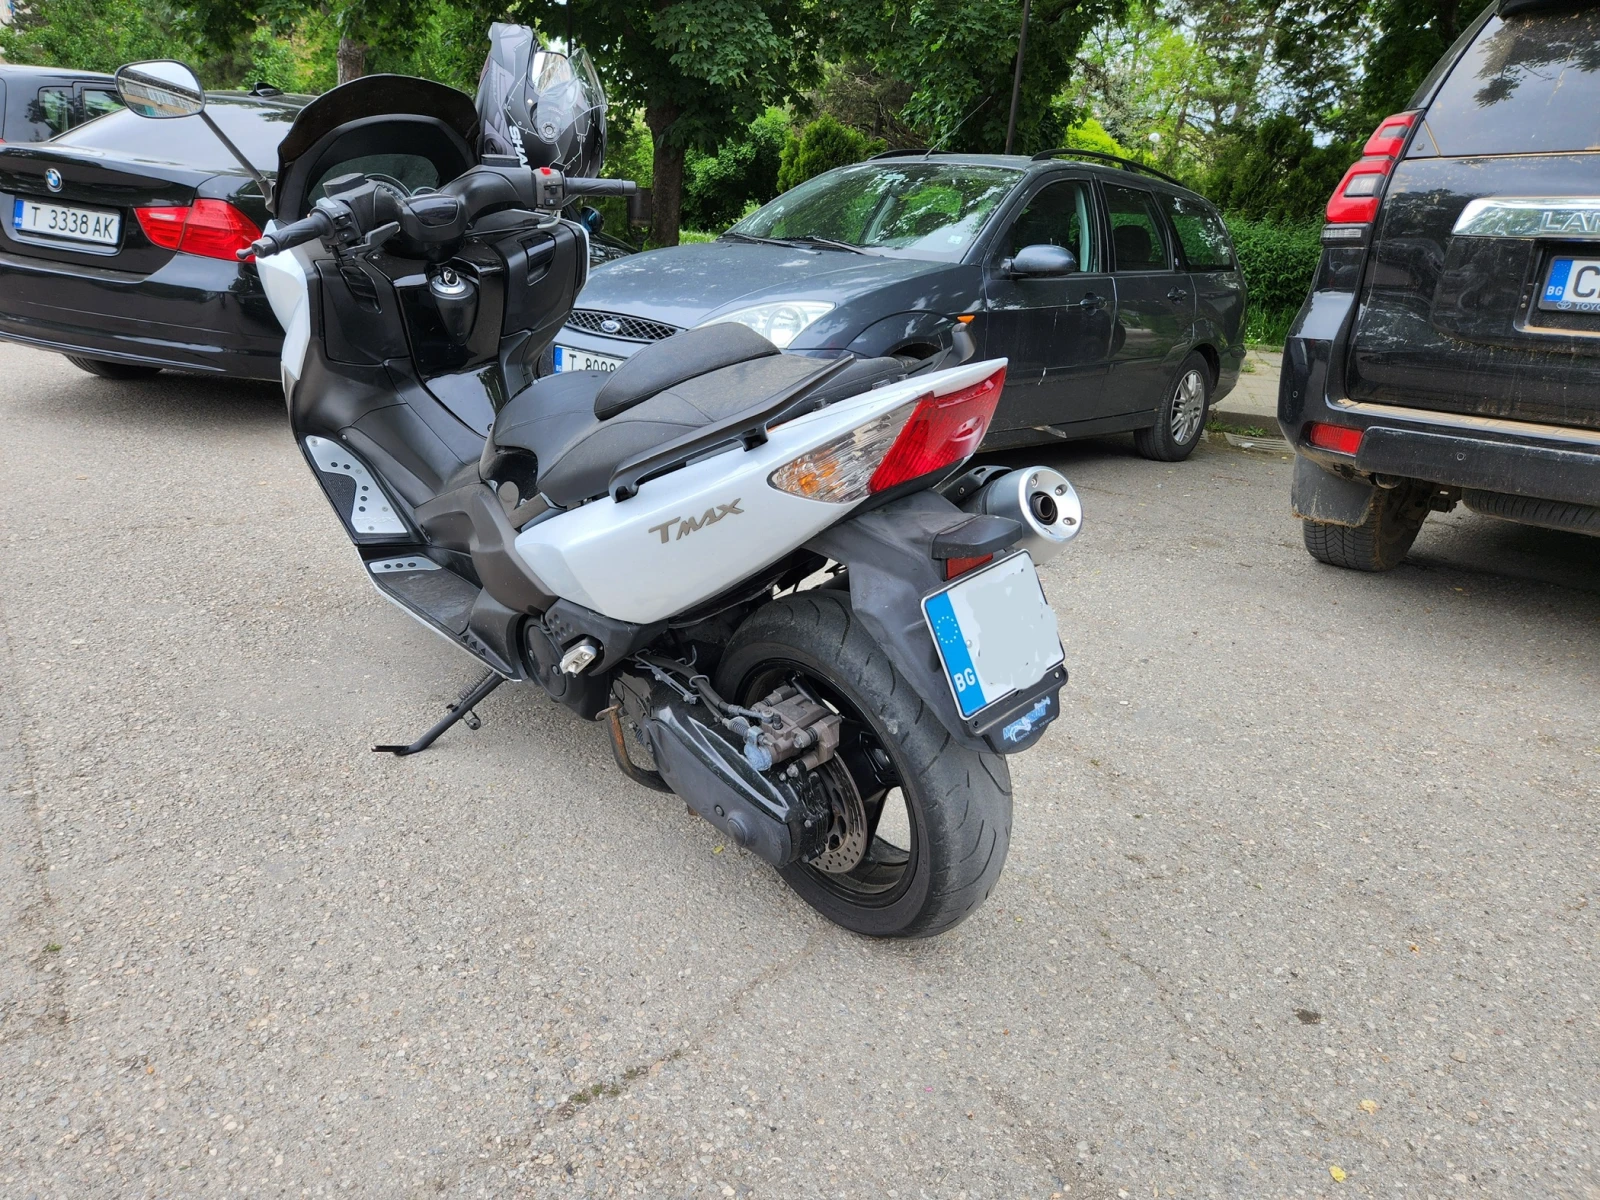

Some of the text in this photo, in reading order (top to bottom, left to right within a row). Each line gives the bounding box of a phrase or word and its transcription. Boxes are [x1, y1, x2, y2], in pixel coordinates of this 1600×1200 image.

[31, 206, 41, 227] T
[48, 209, 89, 235] 3338
[92, 216, 114, 239] AK
[1546, 265, 1600, 298] BG C
[569, 353, 577, 371] T
[648, 497, 745, 544] TMAX
[953, 667, 977, 693] BG
